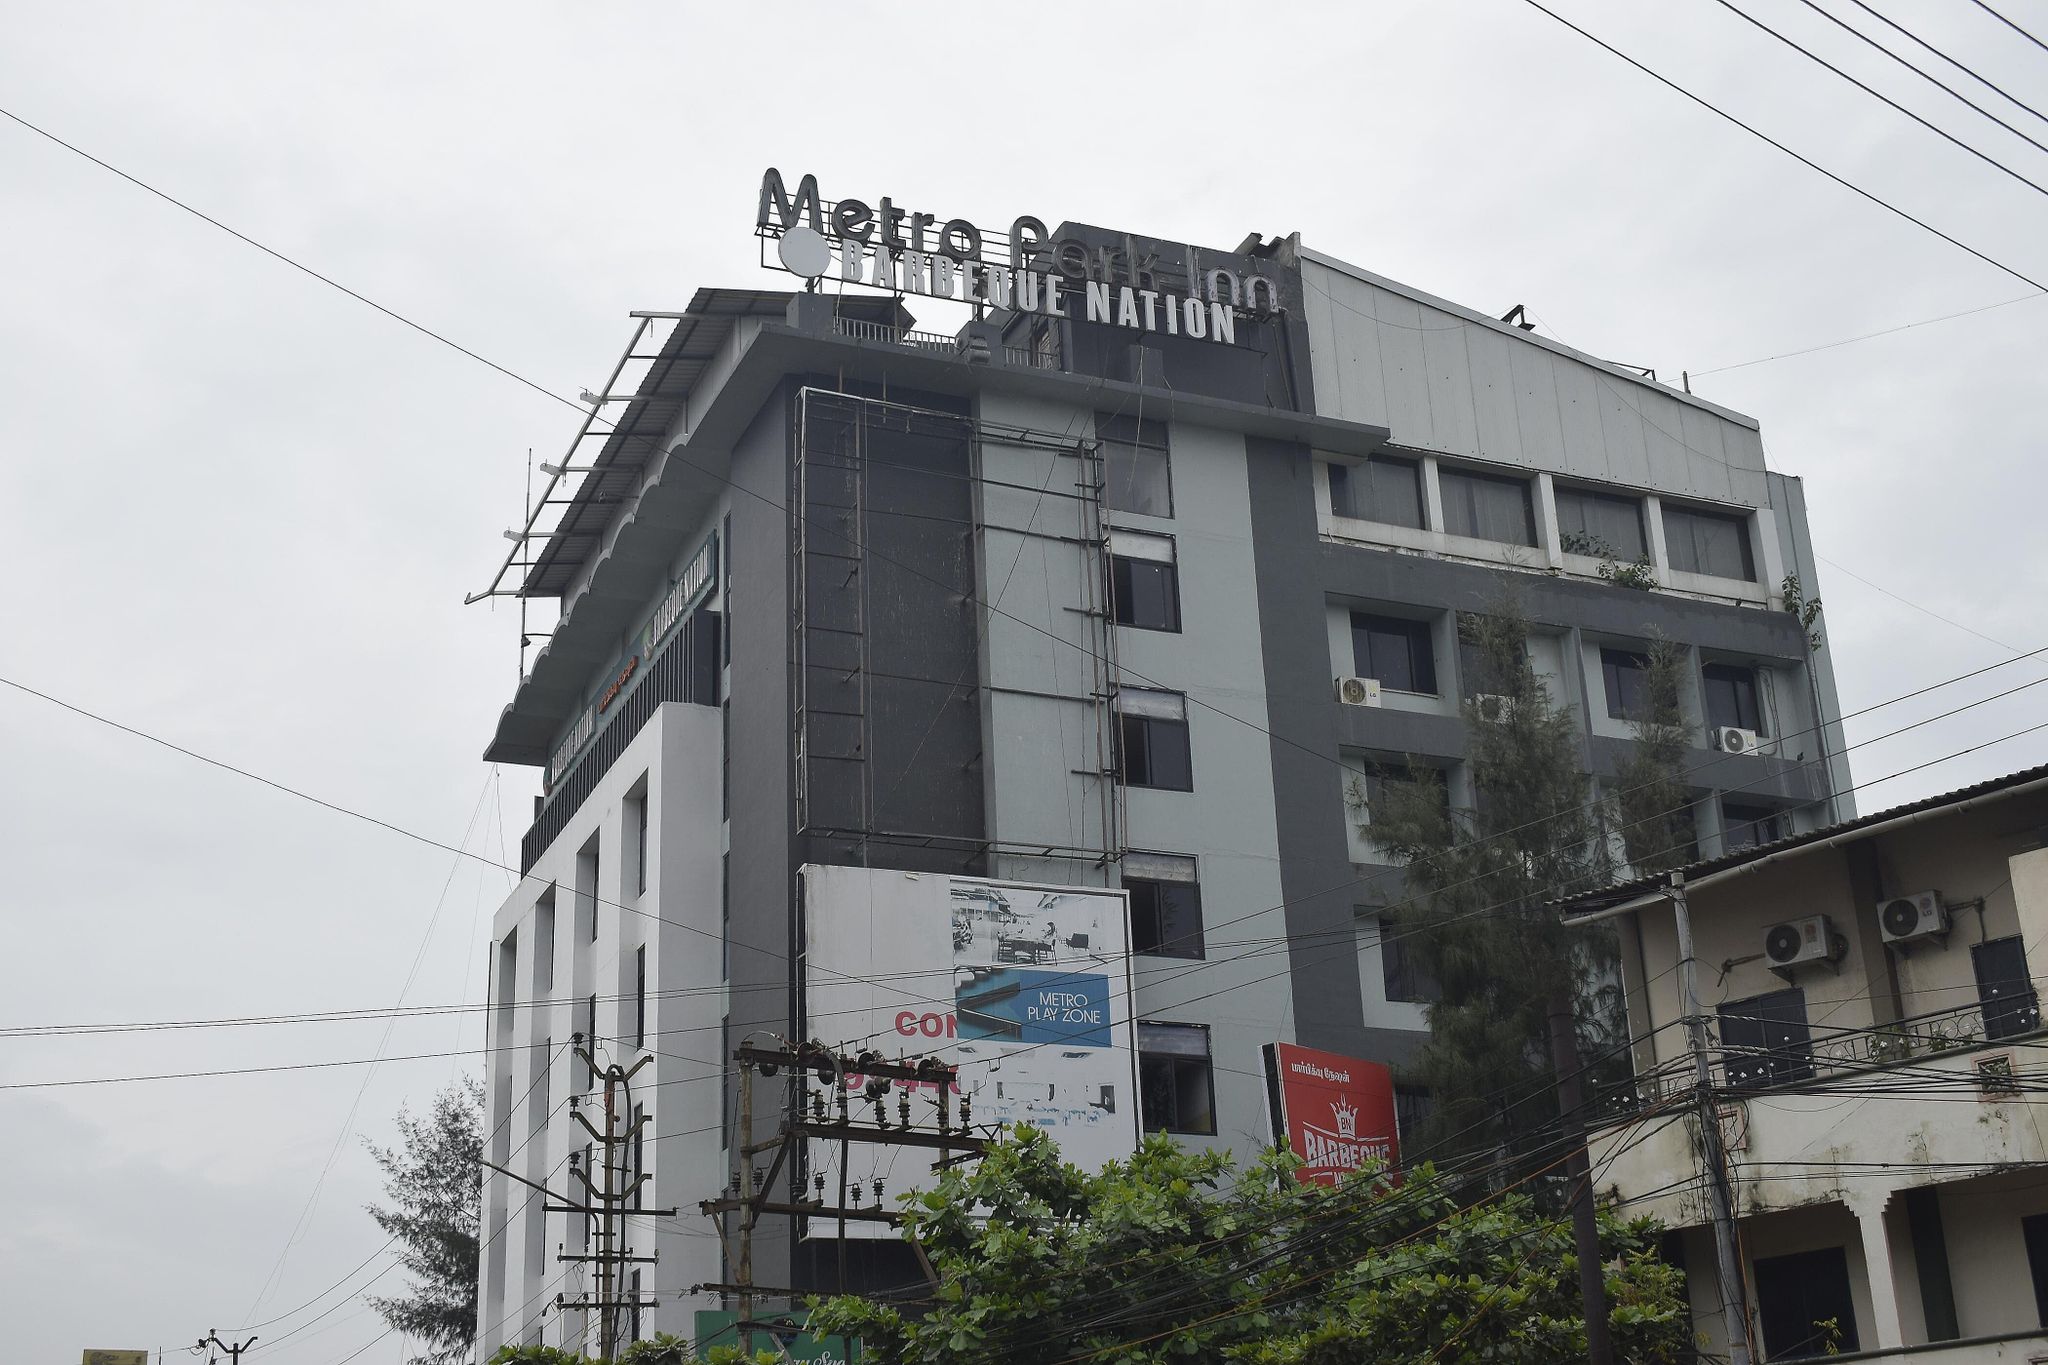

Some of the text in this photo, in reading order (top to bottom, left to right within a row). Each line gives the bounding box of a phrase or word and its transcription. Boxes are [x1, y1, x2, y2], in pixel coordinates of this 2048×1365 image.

[757, 167, 1279, 314] Metro Park Inn
[842, 238, 1236, 344] BARBEQUE NATION
[1028, 1006, 1101, 1024] PLAY ZONE
[1040, 992, 1087, 1007] METRO
